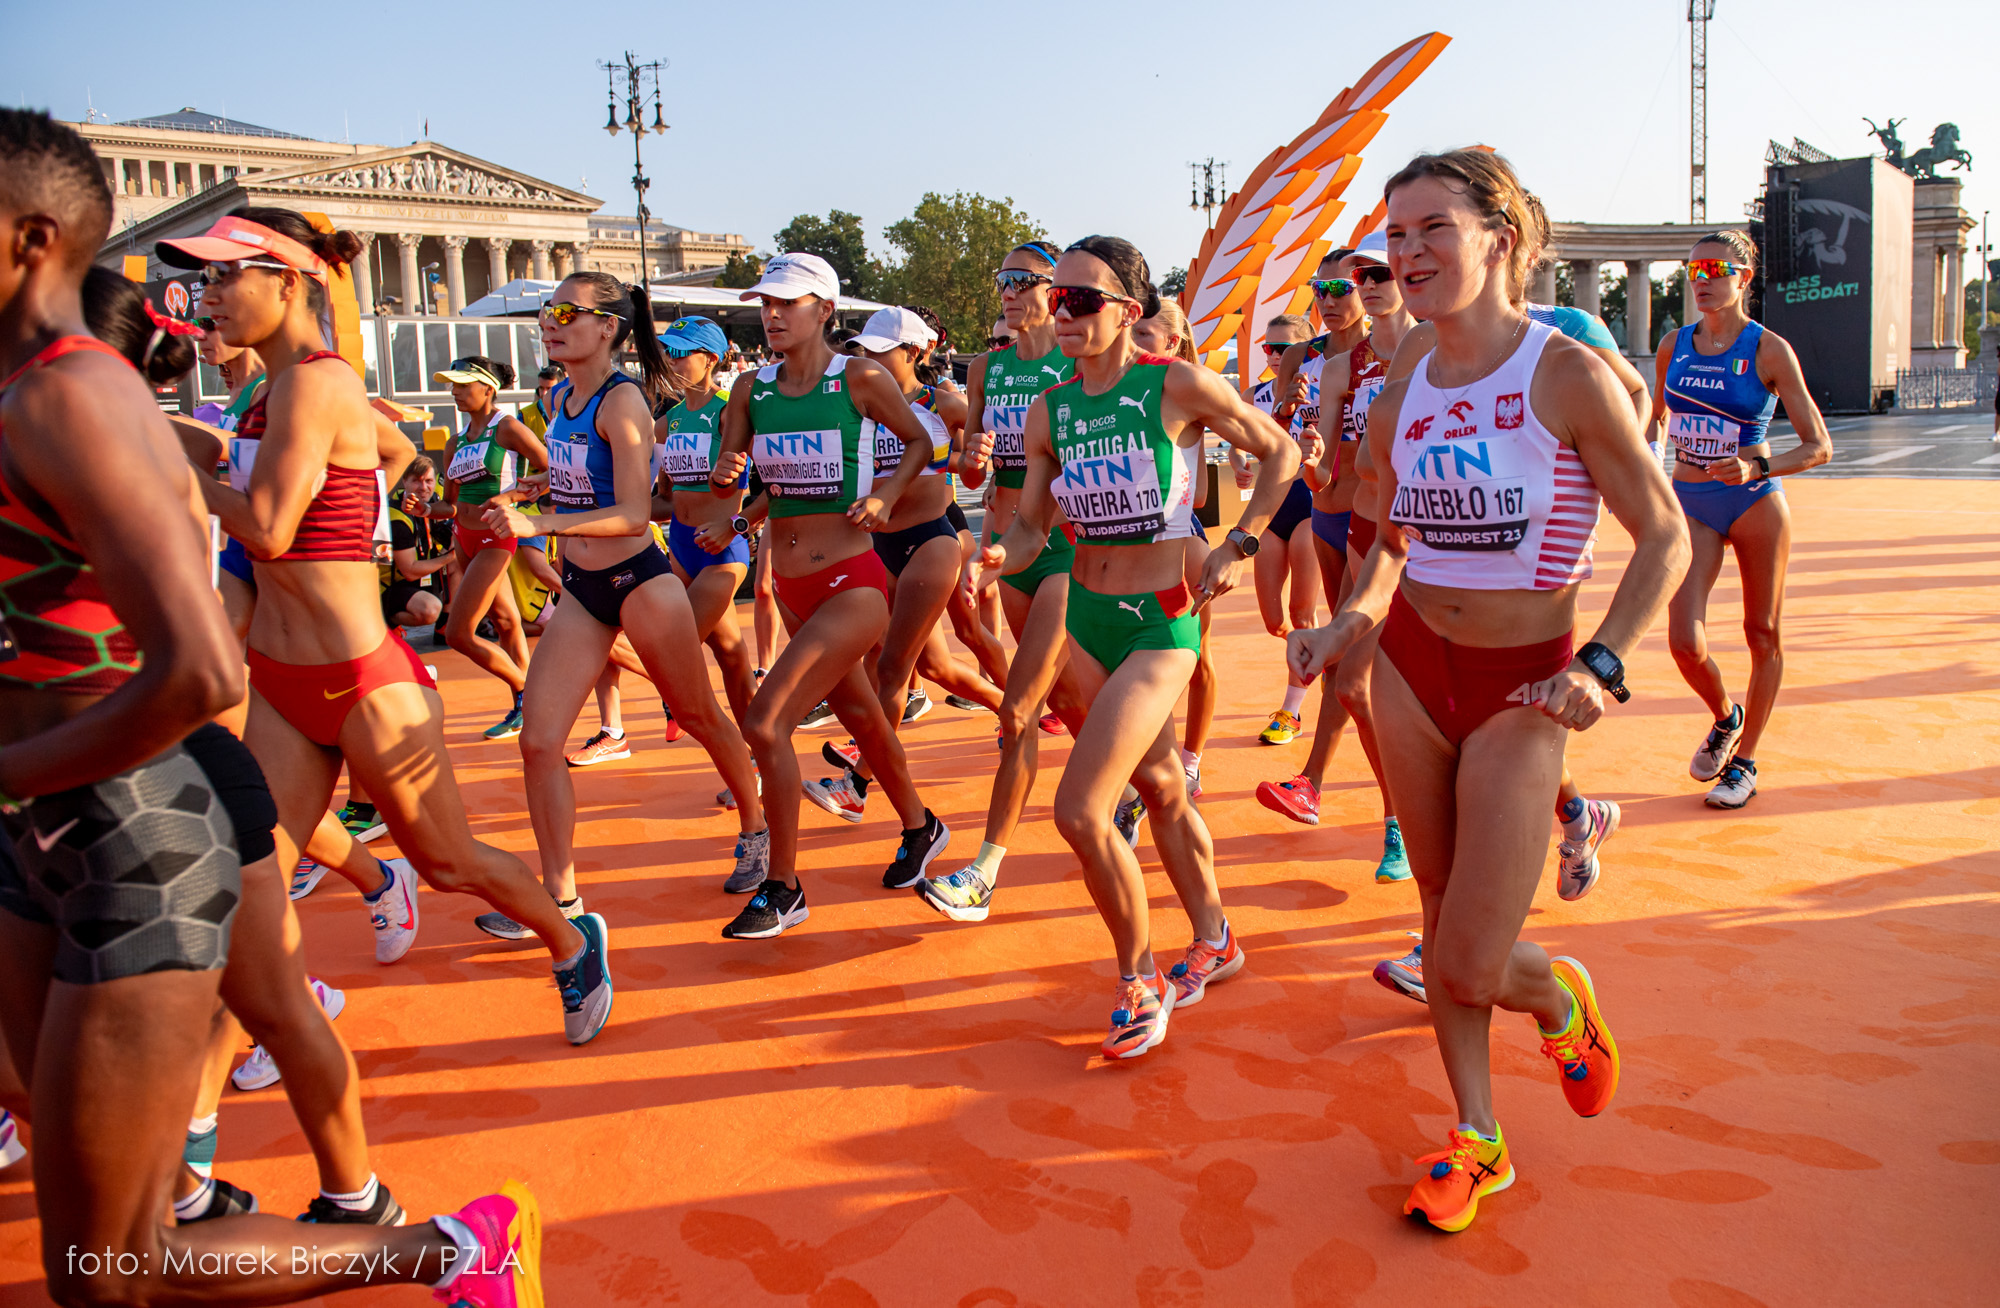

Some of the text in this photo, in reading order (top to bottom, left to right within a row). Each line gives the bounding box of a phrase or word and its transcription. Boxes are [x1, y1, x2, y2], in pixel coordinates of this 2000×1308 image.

[190, 282, 204, 290] WORL
[1776, 275, 1820, 292] LASS
[1785, 281, 1859, 304] CSODÁT!
[1014, 375, 1039, 384] JOGOS
[1678, 377, 1725, 390] ITALIA
[993, 407, 1029, 429] NT
[1089, 414, 1116, 431] JOGOS
[1680, 415, 1725, 435] NTN
[1444, 425, 1477, 440] ORLEN
[666, 434, 698, 452] NTN
[766, 433, 823, 457] NTN
[1059, 431, 1148, 467] PORTUGAL
[1721, 442, 1737, 454] 146
[456, 444, 481, 461] NTN
[547, 440, 572, 467] NTN
[1412, 441, 1493, 481] NTN
[449, 459, 475, 478] ORTUÑO
[669, 454, 693, 472] SOUSA
[695, 456, 708, 469] 105
[758, 459, 840, 480] RAMOS RODRÍGUEZ 161
[1064, 455, 1134, 490] NTN
[575, 475, 591, 491] 115
[784, 485, 839, 495] BUDAPEST 23
[551, 493, 594, 505] BUDAPEST 23
[1058, 488, 1159, 519] OLIVEIRA 170
[1494, 487, 1523, 517] 167
[1087, 519, 1159, 536] BUDAPEST 23
[1425, 528, 1522, 544] BUDAPEST 23
